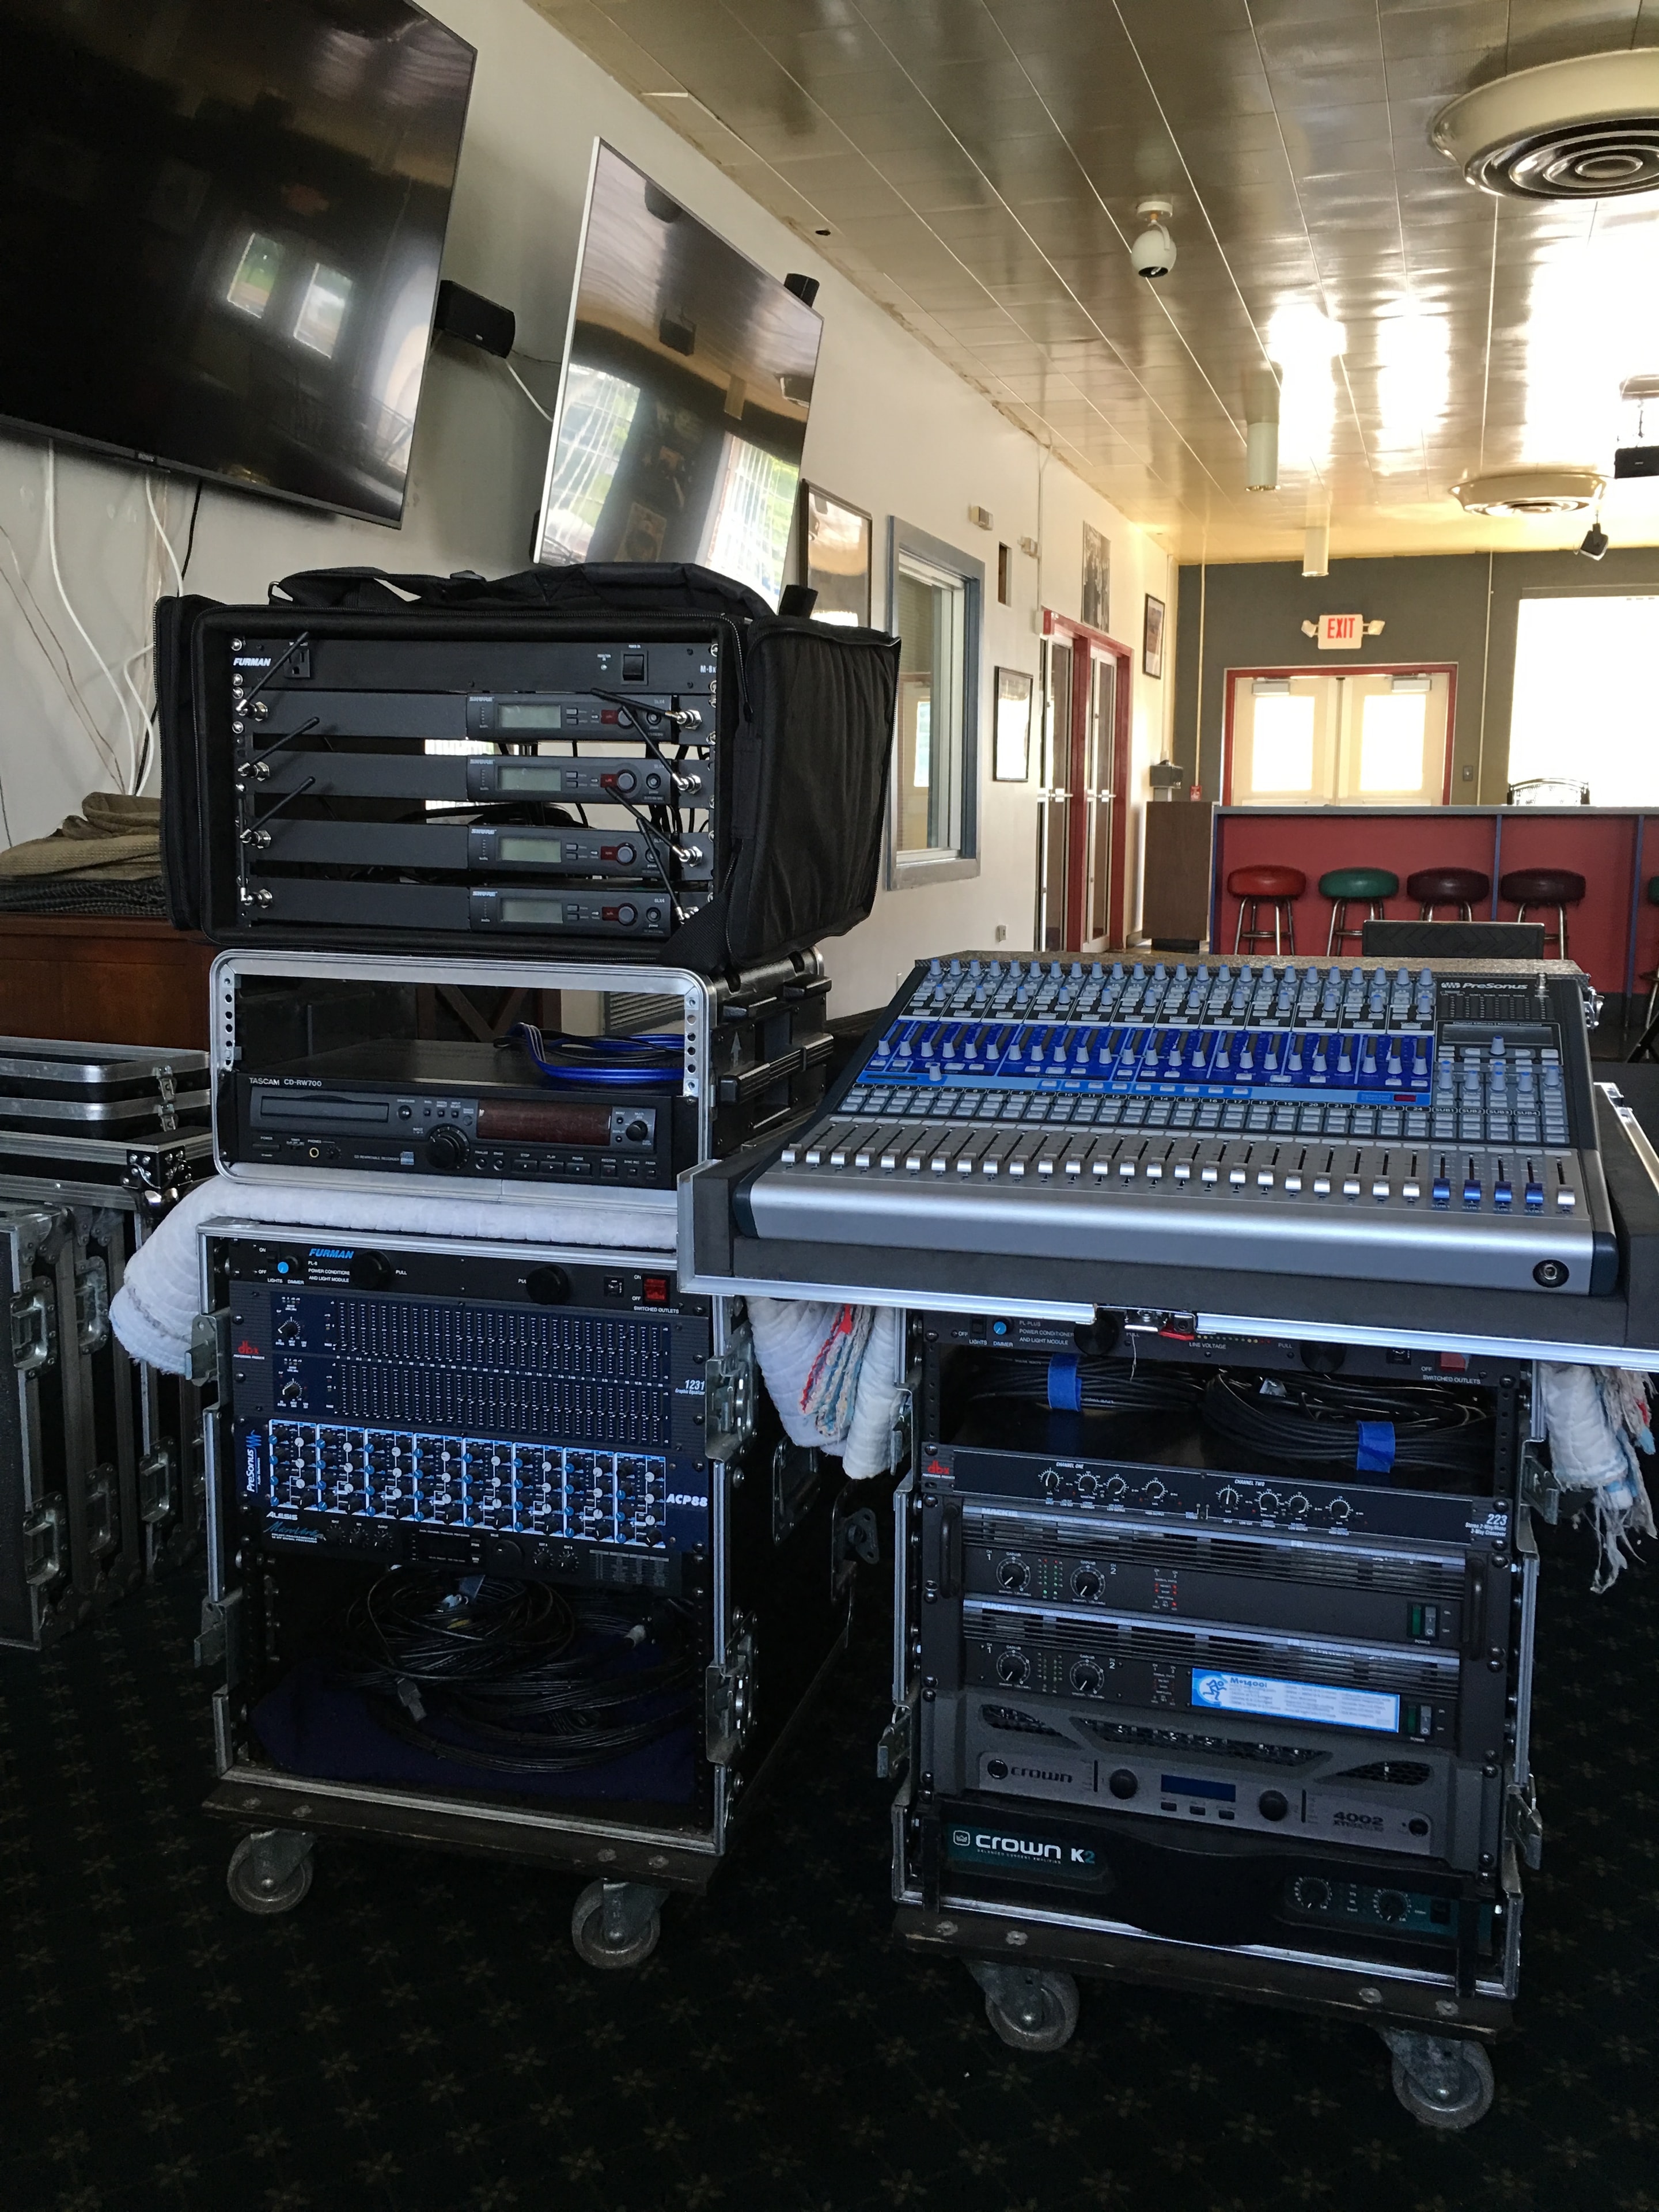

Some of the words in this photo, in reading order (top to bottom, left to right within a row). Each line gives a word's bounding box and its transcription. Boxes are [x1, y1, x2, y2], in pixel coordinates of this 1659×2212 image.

[1327, 618, 1355, 639] EXIT
[233, 658, 271, 666] FURMAN
[1462, 982, 1528, 990] PreSonus
[249, 1077, 280, 1086] TASCAM
[283, 1079, 322, 1087] CD-RW700
[309, 1248, 354, 1259] FURMAN
[238, 1340, 259, 1354] dbx
[685, 1380, 705, 1390] 1231
[246, 1449, 255, 1492] PreSonus
[927, 1460, 950, 1475] dbx
[666, 1493, 708, 1507] ACP88
[266, 1512, 298, 1521] ALESIS
[1486, 1513, 1508, 1525] 223
[1010, 1766, 1073, 1783] crown
[1333, 1812, 1383, 1826] 4002
[976, 1834, 1061, 1859] crown
[1071, 1848, 1095, 1863] K2
